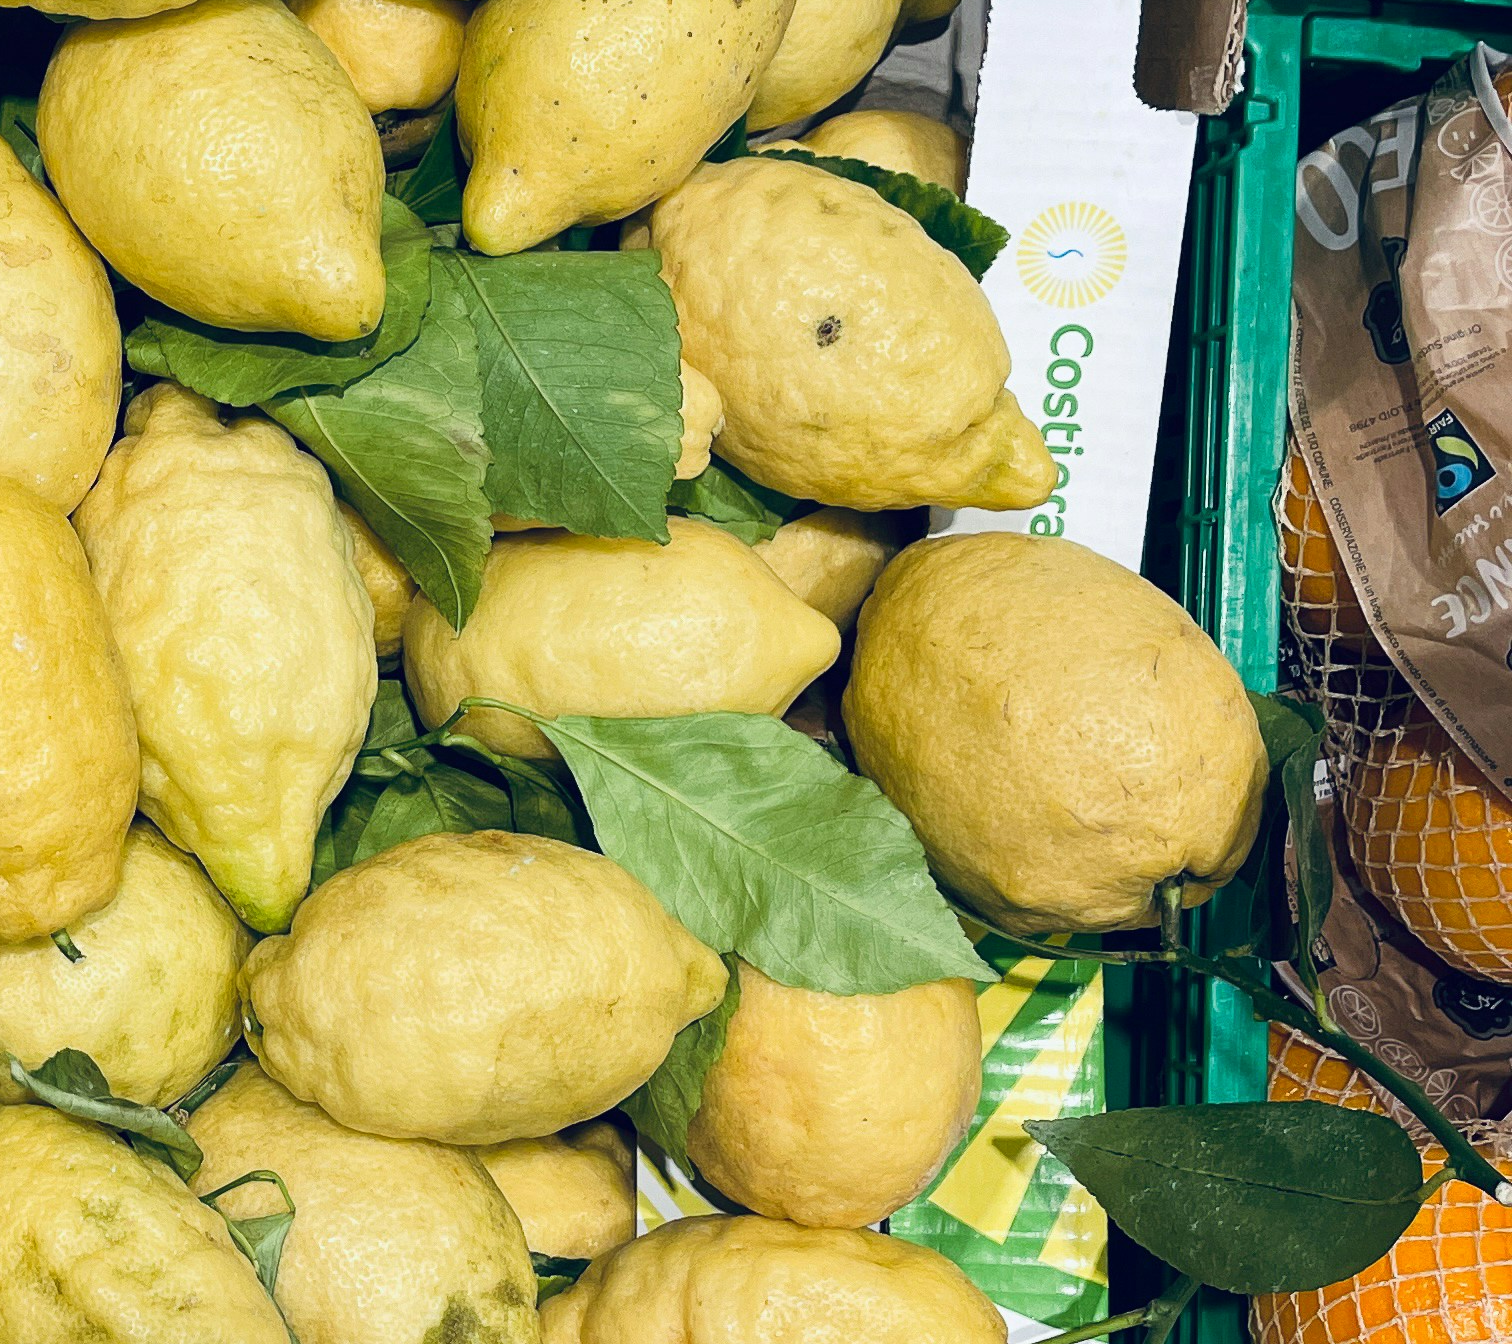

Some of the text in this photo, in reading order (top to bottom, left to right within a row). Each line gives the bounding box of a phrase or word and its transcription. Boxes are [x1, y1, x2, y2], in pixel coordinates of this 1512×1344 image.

[1427, 413, 1454, 439] FAIR
[1303, 432, 1320, 450] TUO
[1312, 451, 1335, 490] COMUNE
[1419, 679, 1438, 700] cura
